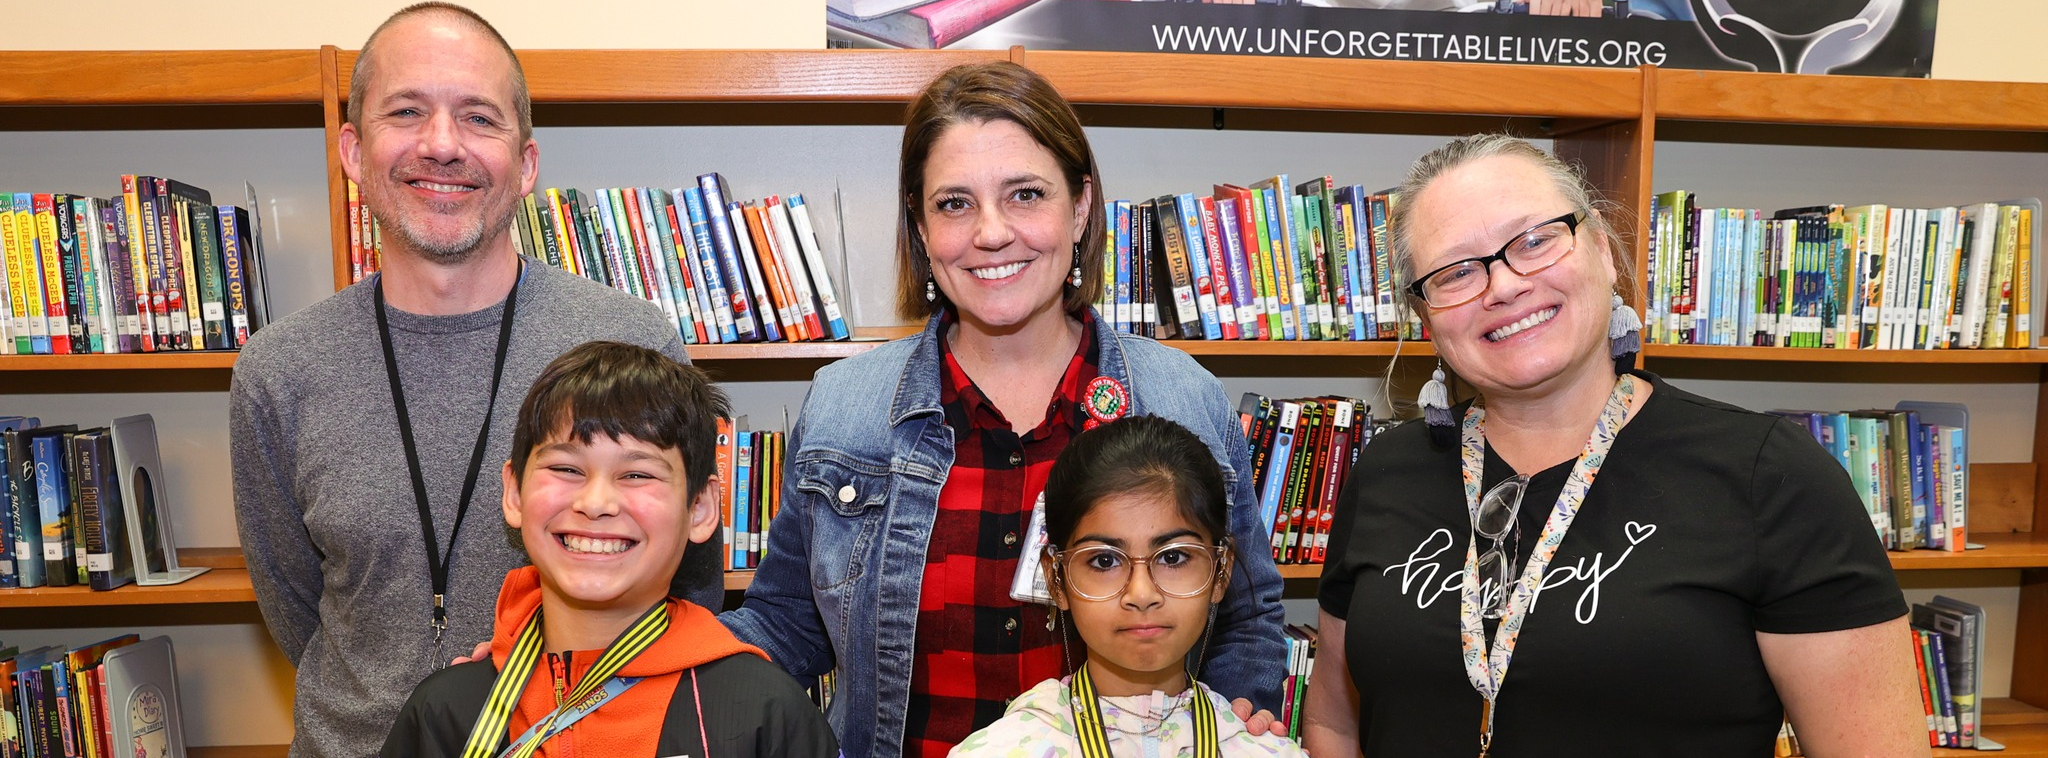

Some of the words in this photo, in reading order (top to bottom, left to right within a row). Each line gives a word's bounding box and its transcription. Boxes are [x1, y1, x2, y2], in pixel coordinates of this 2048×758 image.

[1152, 25, 1667, 67] WWW.UNFORGETTABLELIVES.ORG
[115, 201, 126, 236] VOYAGERS
[653, 197, 663, 216] PECK
[58, 204, 69, 240] VOYAGERS
[128, 214, 139, 255] CLEOPATRA
[143, 201, 157, 245] CLEOPATRA
[200, 222, 209, 242] NEW
[1205, 210, 1216, 233] BABY
[2, 214, 19, 279] CLUELESS
[20, 214, 33, 266] CLUELESS
[39, 213, 54, 269] CLUELESS
[222, 215, 240, 279] DRAGON
[696, 229, 712, 255] THE
[1167, 225, 1179, 254] LOST
[1337, 231, 1346, 246] YETI
[1372, 219, 1387, 252] Walls
[79, 231, 91, 272] ATHLETE
[148, 246, 158, 254] IN
[161, 215, 173, 259] CLEOPATRA
[167, 267, 177, 290] SPAC
[1339, 247, 1347, 266] FILES
[64, 255, 75, 281] PROJECT
[149, 254, 161, 279] SPACE
[202, 245, 215, 287] DRAGON
[703, 259, 721, 286] BEST
[1172, 256, 1185, 286] PLAN
[1272, 239, 1285, 271] WEDGIE
[1279, 275, 1291, 305] GIZMO
[1957, 258, 1967, 298] NAVIGATING
[67, 284, 78, 305] ALPHA
[1267, 281, 1277, 297] GIZM
[2021, 260, 2030, 303] Paperboy
[229, 281, 243, 310] OPS
[1955, 299, 1963, 314] EARL
[1103, 379, 1115, 387] THE
[1114, 384, 1126, 407] SEASON
[1252, 420, 1262, 440] BONE
[1262, 429, 1272, 448] BONE
[1297, 428, 1305, 447] BONE
[1309, 428, 1317, 447] BONE
[717, 451, 727, 460] A
[1257, 452, 1265, 467] OLD
[1319, 451, 1327, 468] ROSE
[717, 460, 727, 484] Good
[1289, 452, 1301, 487] TREASURE
[1953, 474, 1963, 490] SAVE
[81, 486, 99, 518] FIREFLY
[1283, 487, 1293, 513] HUNTE
[1327, 485, 1335, 501] SPARK
[1953, 492, 1963, 503] ME
[12, 495, 22, 533] BICYCLE
[577, 690, 608, 713] SONIC
[50, 711, 60, 738] SQUINT
